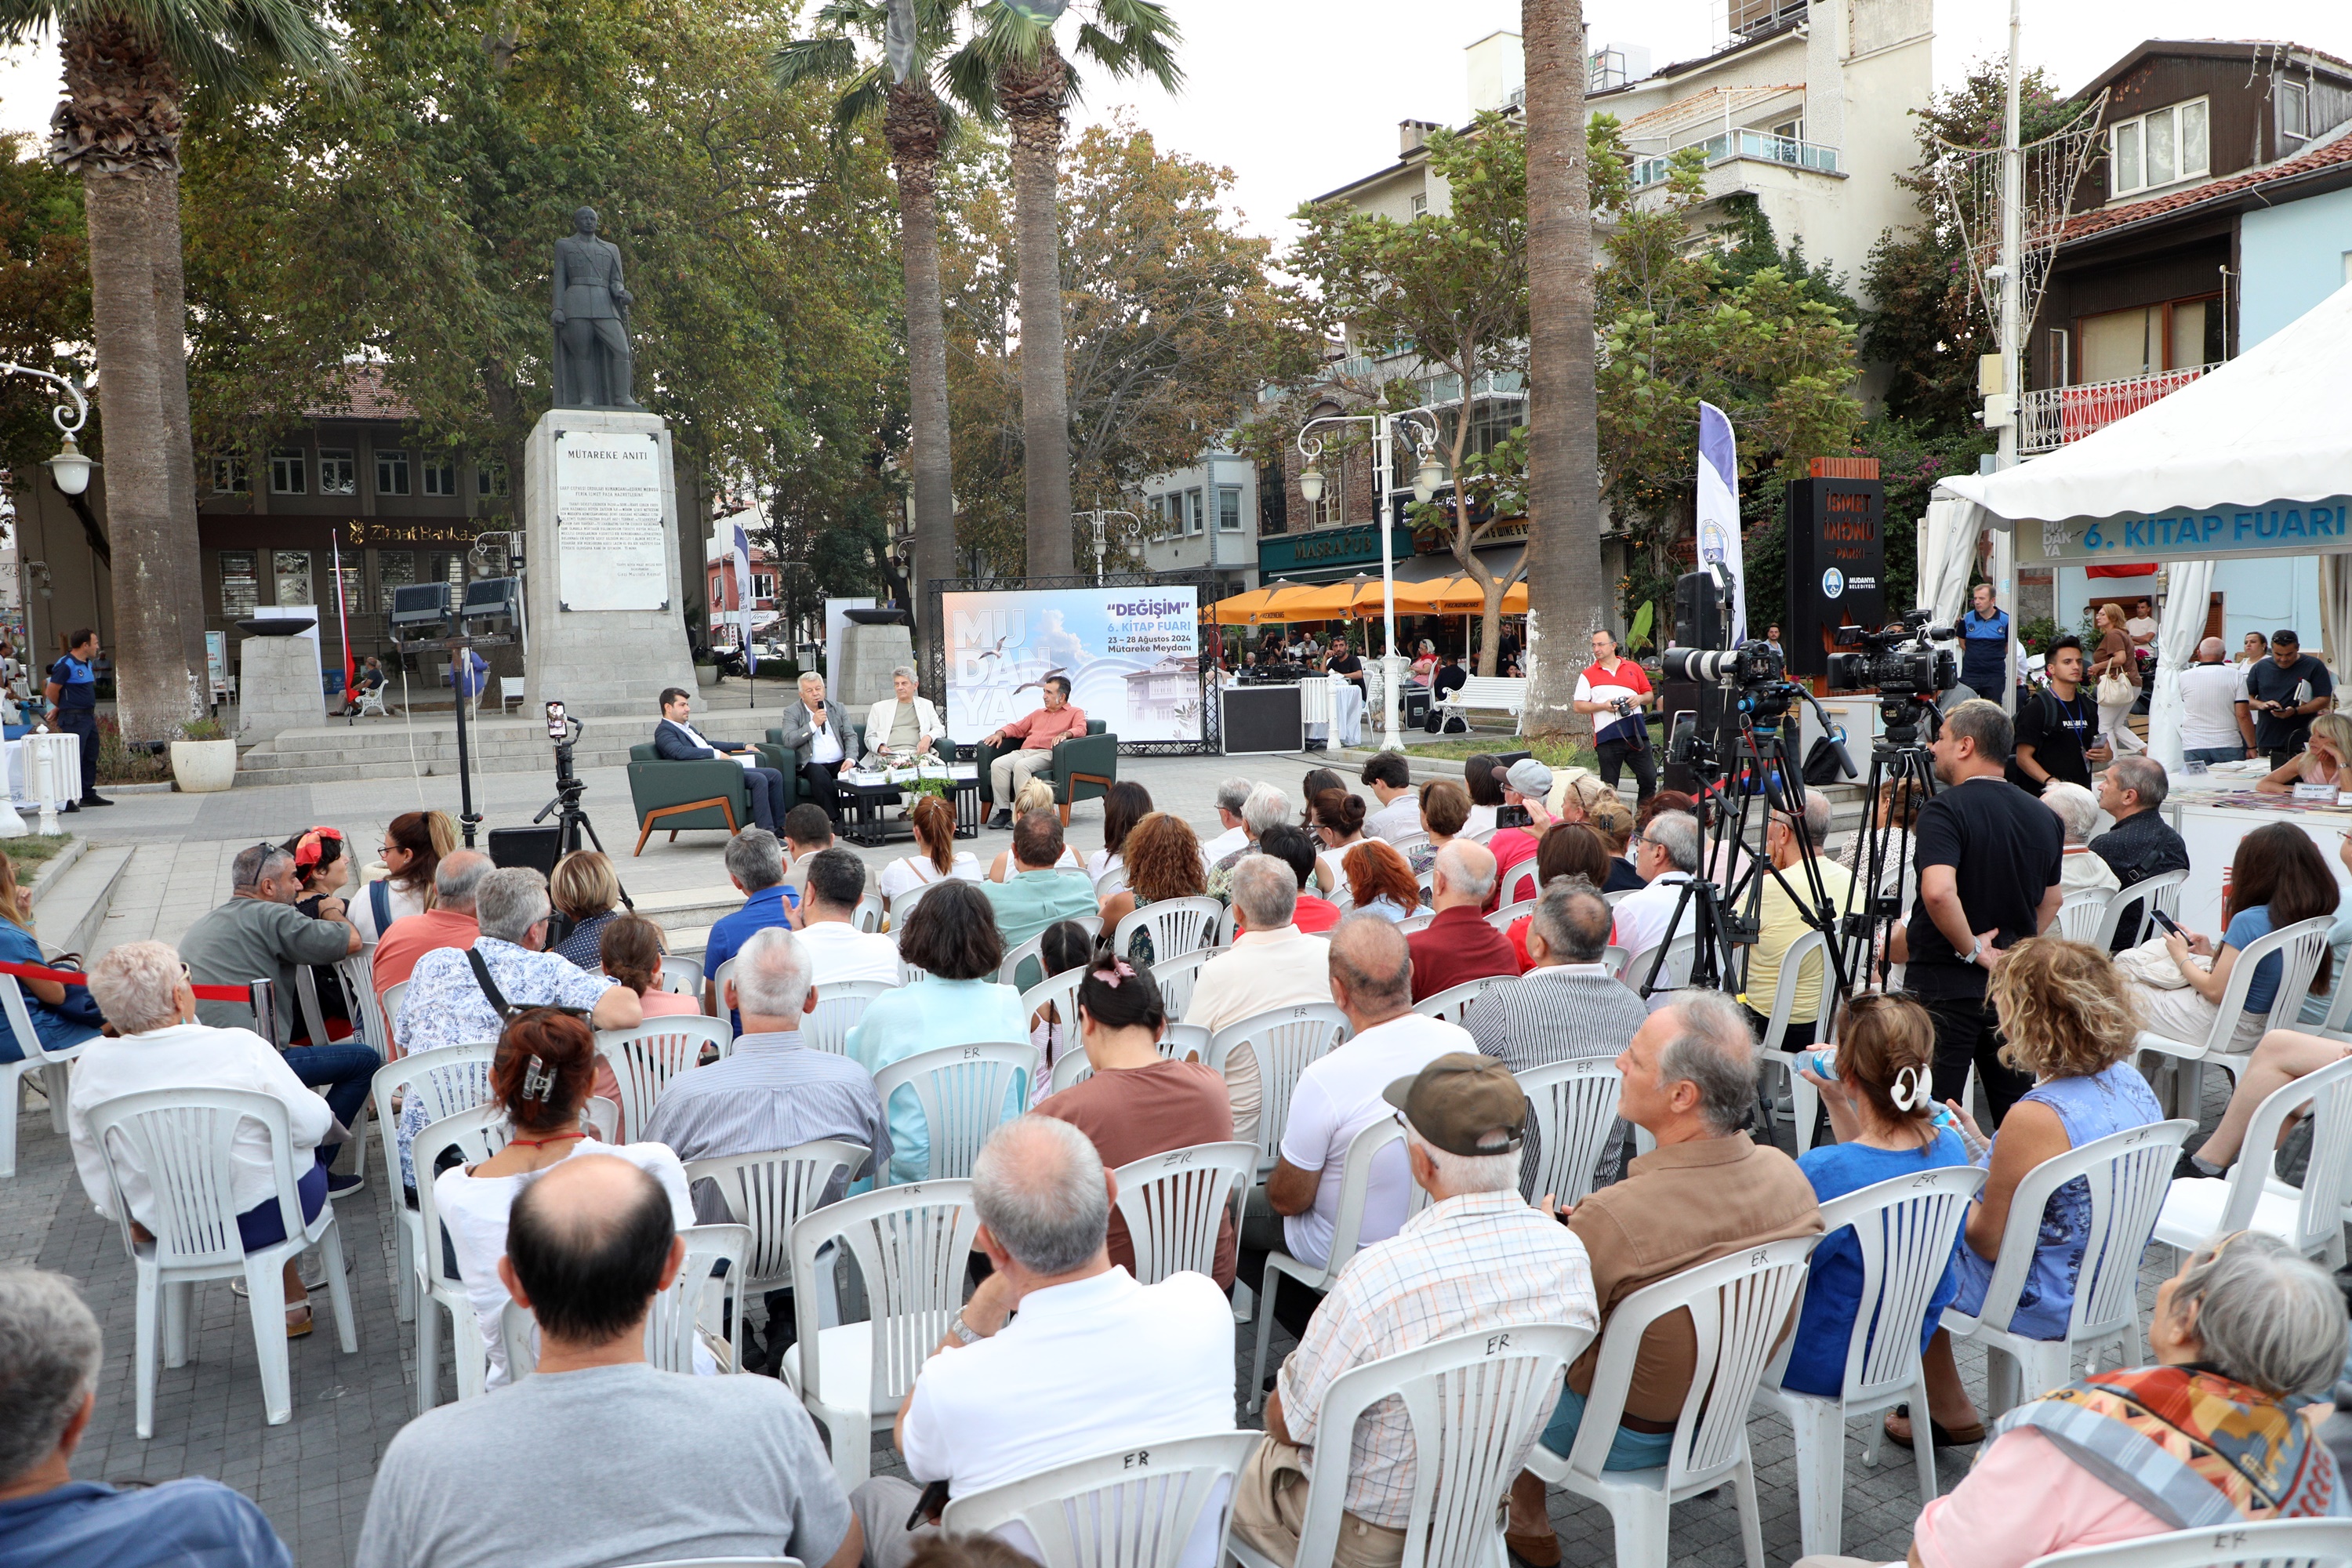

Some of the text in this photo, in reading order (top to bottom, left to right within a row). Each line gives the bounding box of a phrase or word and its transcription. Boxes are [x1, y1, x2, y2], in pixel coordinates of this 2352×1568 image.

[568, 449, 648, 460] MÜTAREKE ANITI
[1826, 488, 1871, 512] İSMET
[370, 524, 418, 541] Ziraat
[1497, 524, 1515, 537] WINE
[1824, 516, 1875, 541] İNÖNÜ
[2083, 506, 2346, 550] 6. KİTAP FUARI
[2042, 532, 2071, 545] DAN
[1835, 547, 1866, 560] PARKI
[2042, 545, 2061, 557] YA
[953, 608, 1025, 648] MU
[1107, 620, 1191, 633] 6. KİTAP FUARI
[1138, 635, 1170, 644] Ağustos
[1108, 643, 1191, 653] Mütareke Meydanı
[956, 687, 1018, 726] YA
[1175, 900, 1186, 909] ER
[1205, 949, 1218, 960] ER
[1479, 980, 1491, 989] ER
[1294, 1007, 1307, 1018] ER
[964, 1047, 981, 1059] ER
[1577, 1062, 1594, 1073] ER
[1163, 1151, 1192, 1167] ER
[904, 1185, 921, 1196] ER
[1751, 1250, 1769, 1267] ER
[1486, 1334, 1510, 1355] ER
[1124, 1450, 1149, 1469] ER
